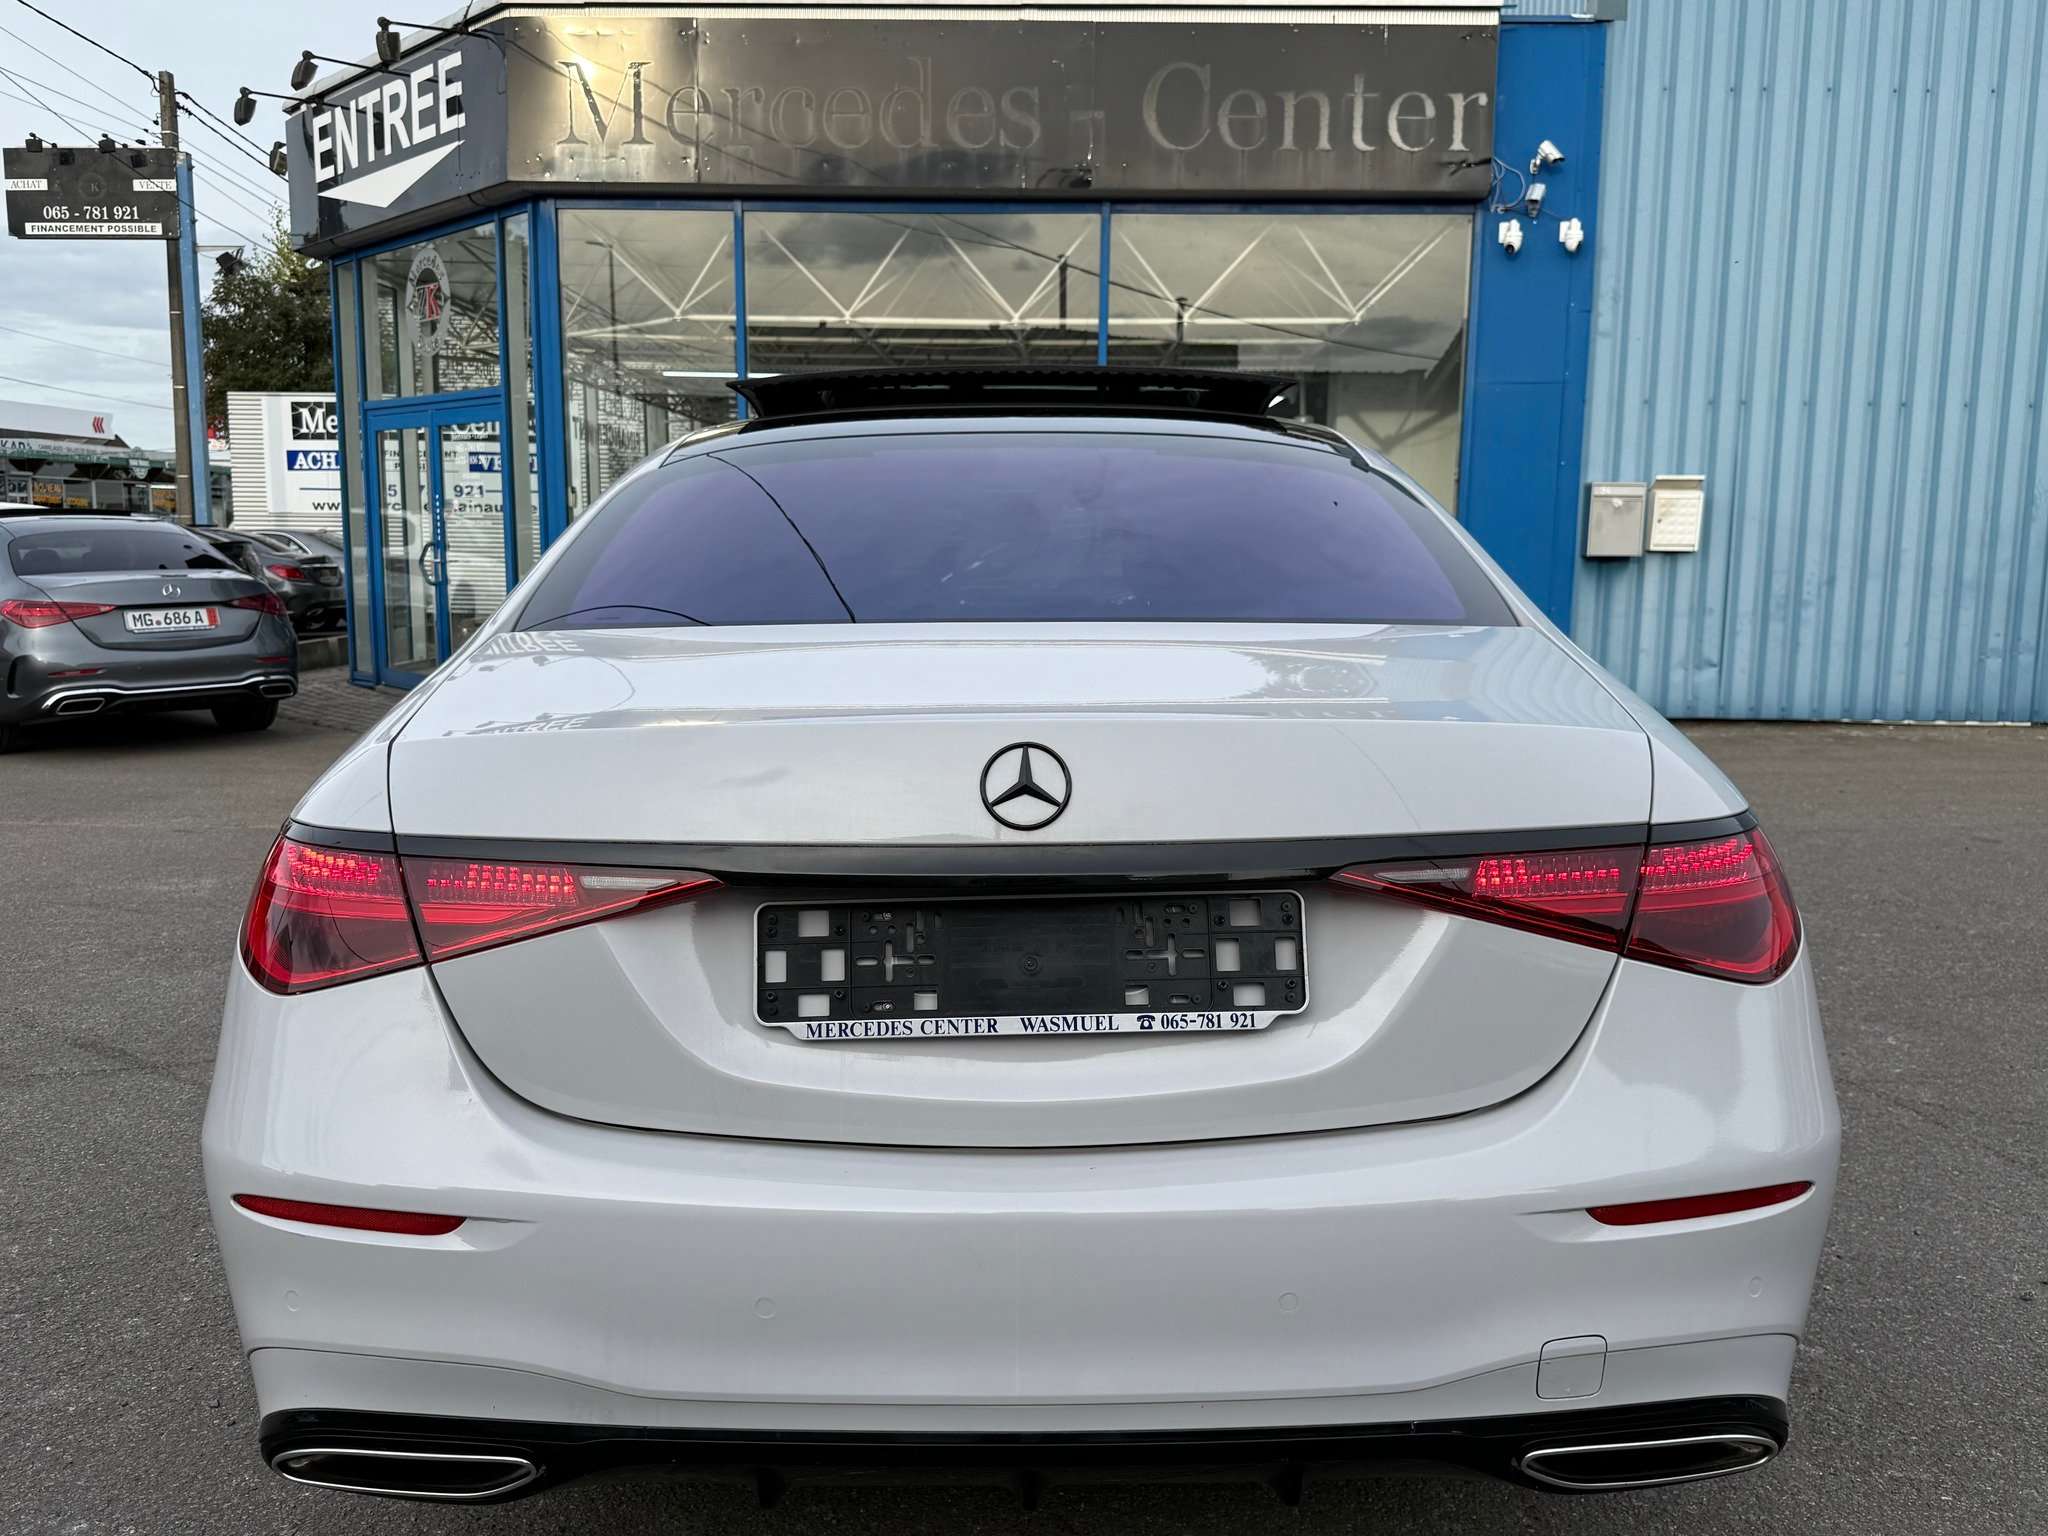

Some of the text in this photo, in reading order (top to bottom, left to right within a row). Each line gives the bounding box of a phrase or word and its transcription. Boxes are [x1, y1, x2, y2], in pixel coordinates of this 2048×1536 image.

[557, 56, 1041, 150] Mercedes
[1142, 61, 1489, 152] Center
[312, 51, 466, 183] ENTREE
[10, 180, 43, 189] ACHAT
[138, 181, 172, 190] VENTE
[43, 205, 70, 220] 065
[83, 205, 109, 220] 781
[113, 205, 140, 220] 921
[31, 224, 157, 233] FINANCEMENT POSSIBLE
[293, 451, 340, 470] ACH
[453, 484, 485, 498] 921
[132, 610, 204, 627] MG 686 A
[806, 1012, 1256, 1038] MERCEDES CENTER WASMUEL 065-781 921
